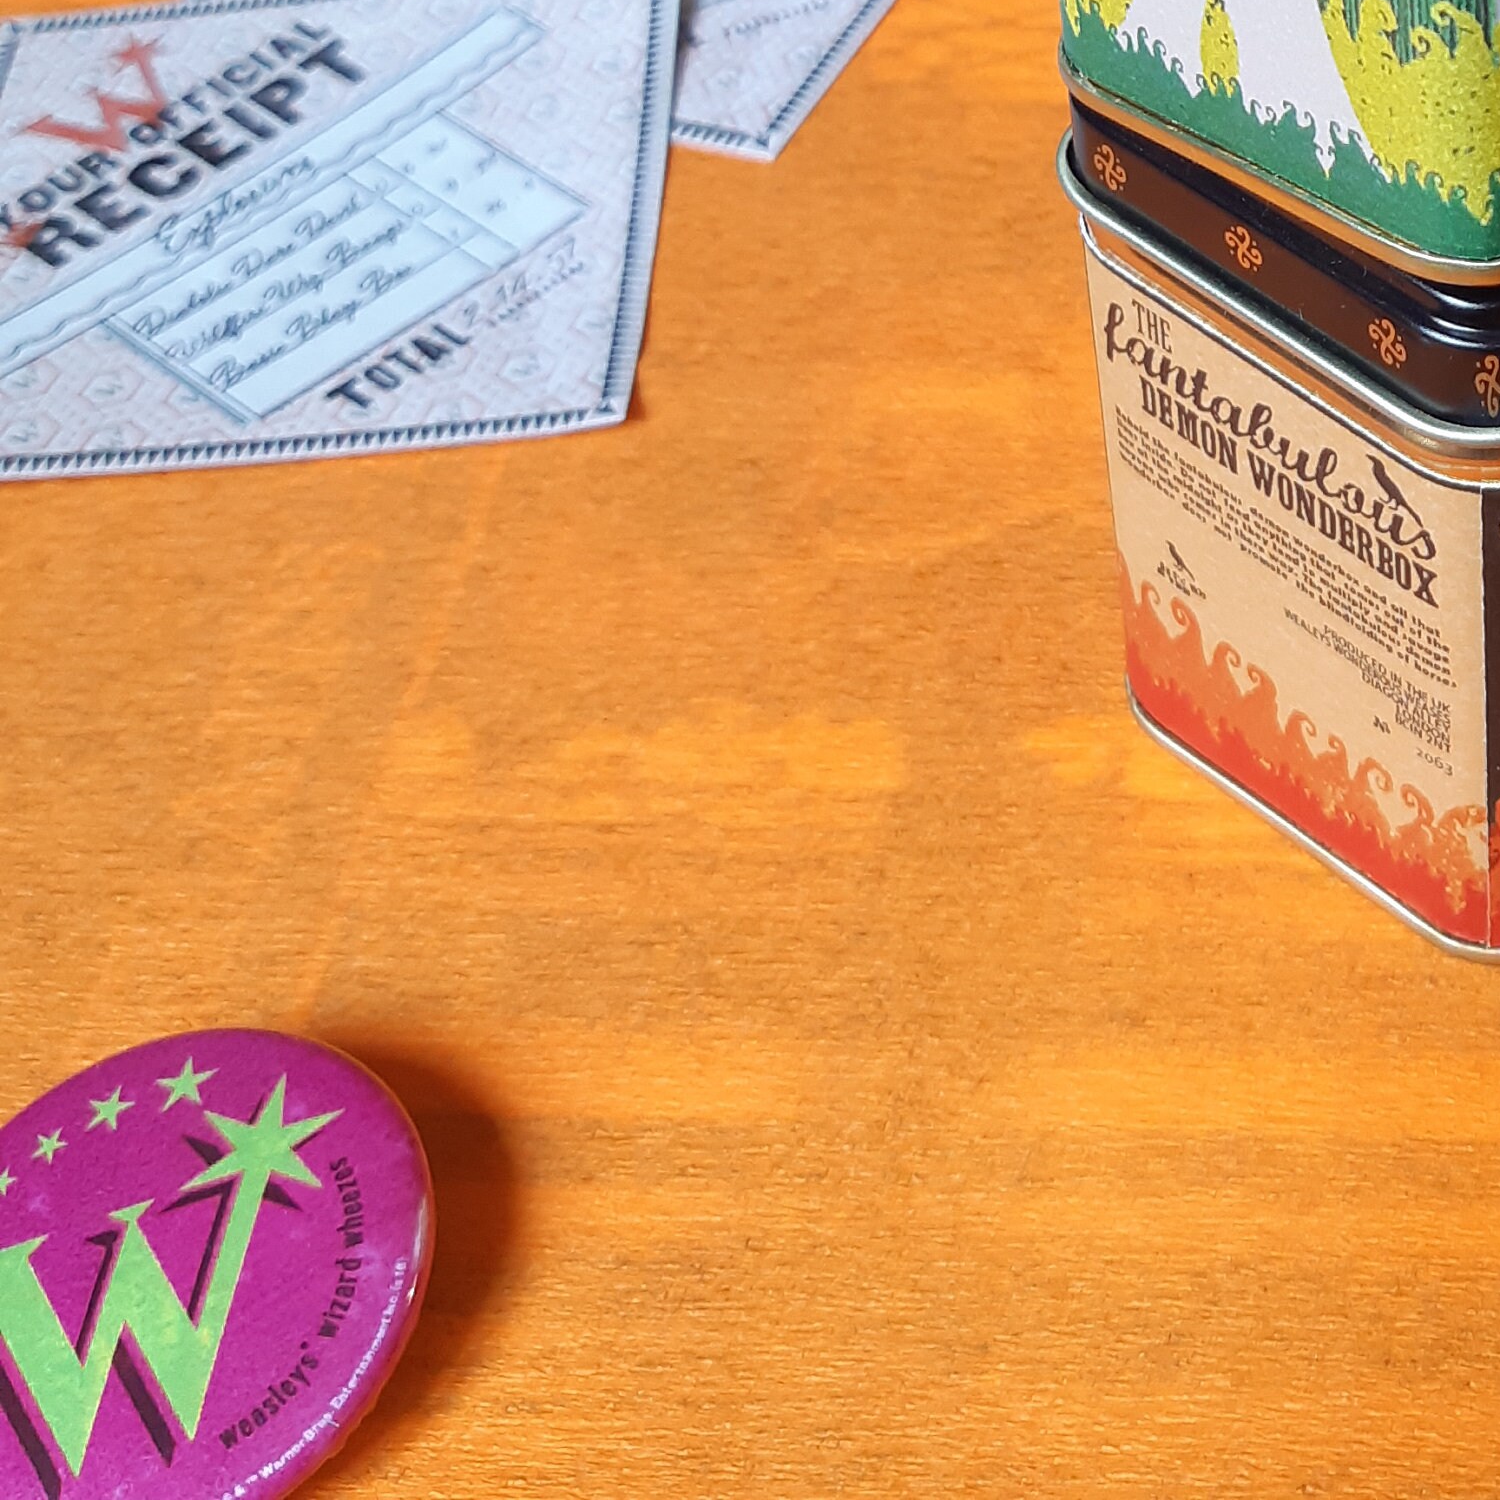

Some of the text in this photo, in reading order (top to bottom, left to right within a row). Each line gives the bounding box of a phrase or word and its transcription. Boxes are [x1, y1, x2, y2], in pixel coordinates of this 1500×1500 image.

[128, 20, 330, 146] OFFICIAL
[26, 38, 366, 267] RECEIPT
[326, 323, 473, 409] TOTAL
[1131, 298, 1174, 354] THE
[1104, 300, 1437, 562] fantabulous
[1139, 374, 1440, 609] DEMON WONDERBOX
[1364, 585, 1387, 605] and
[1411, 615, 1441, 638] that
[1374, 614, 1399, 635] and
[1426, 636, 1450, 653] the
[1405, 645, 1451, 676] demon
[1416, 748, 1453, 776] 2063
[330, 1156, 365, 1248] wheezes
[318, 1258, 363, 1338] wizard
